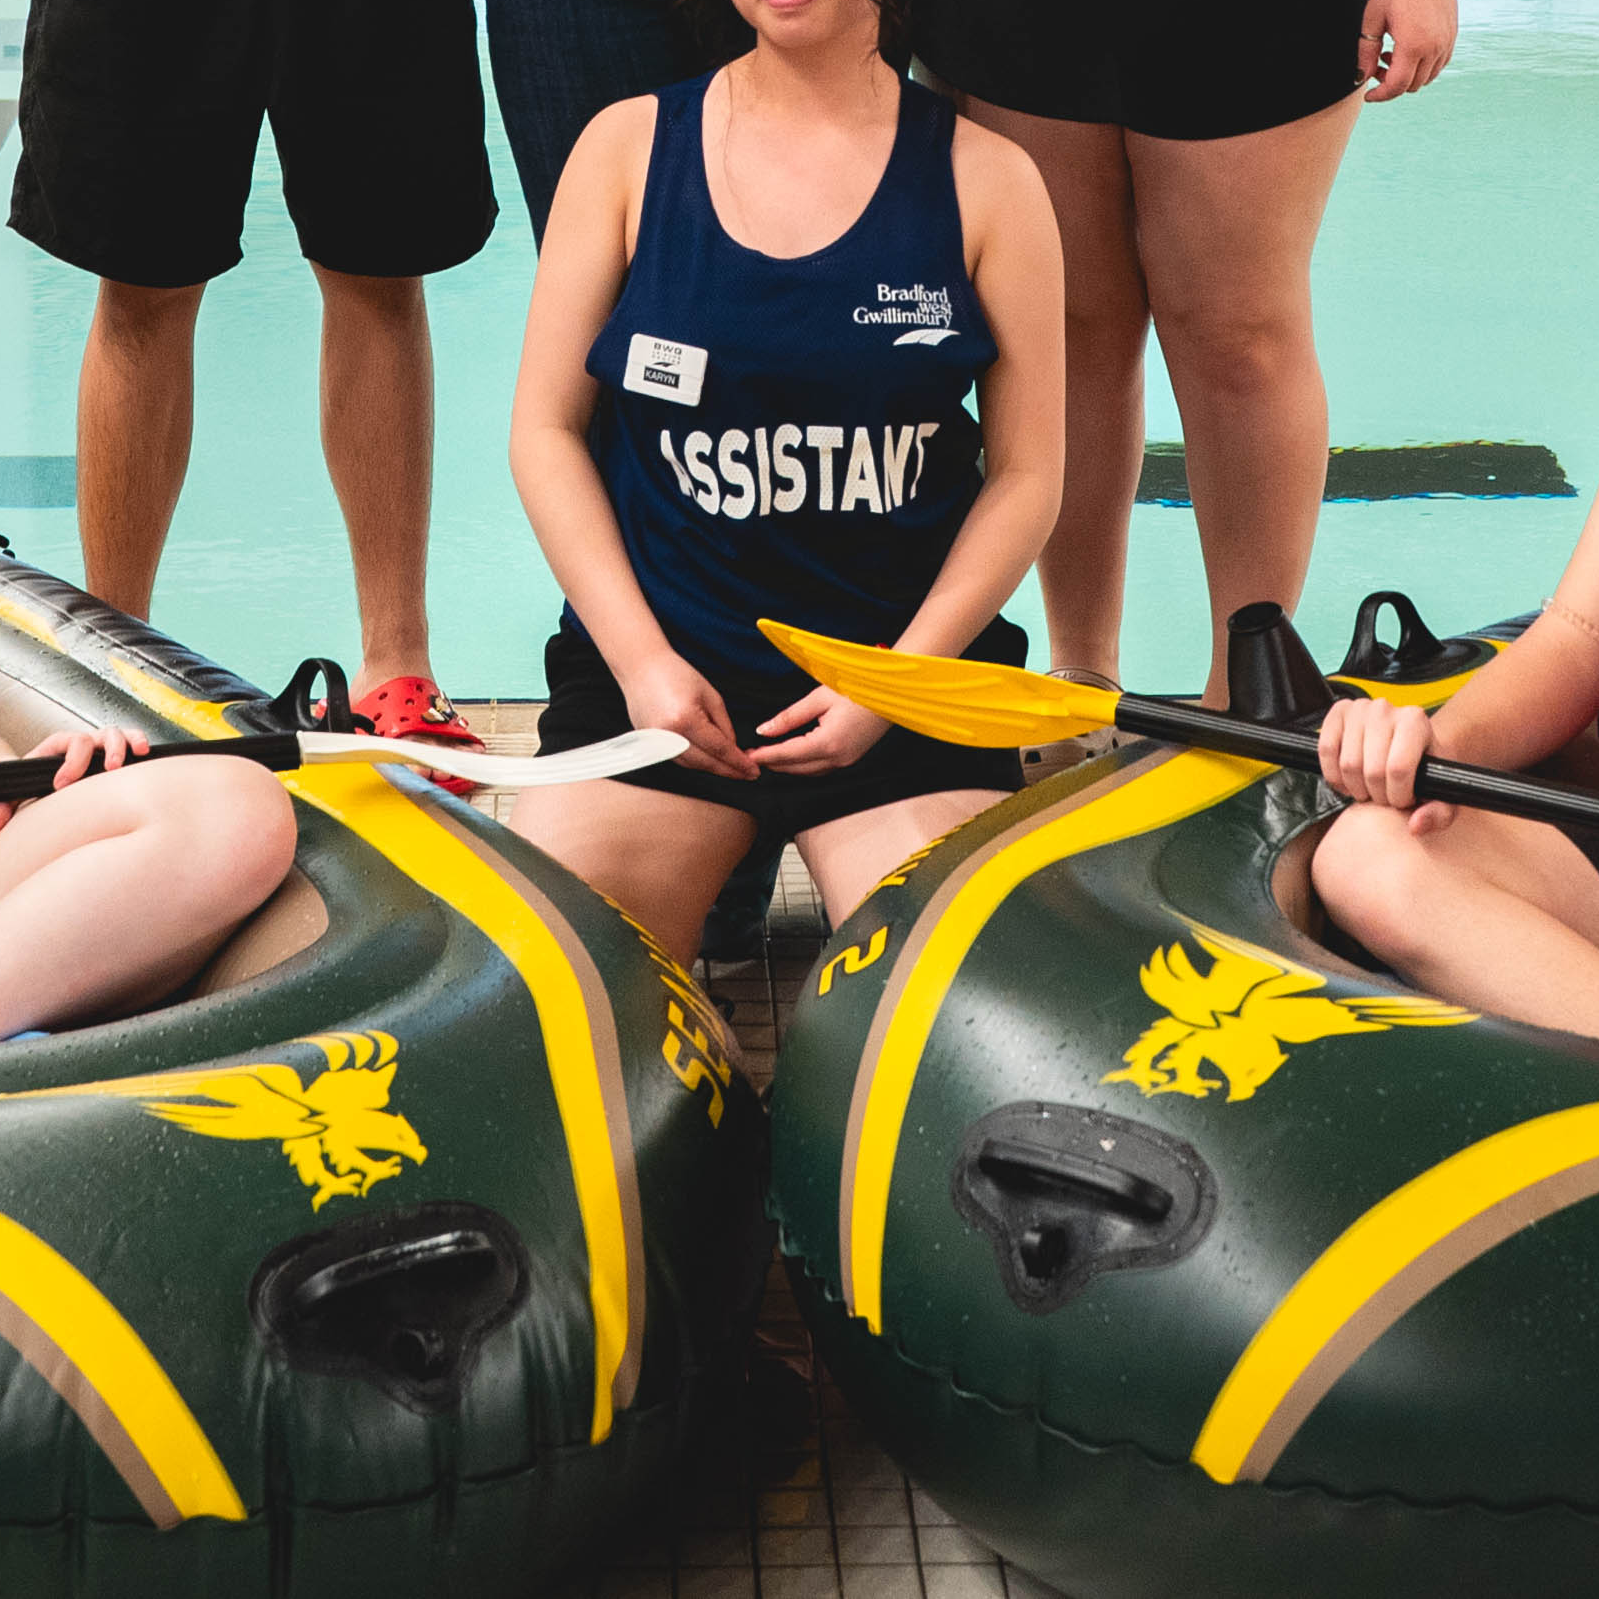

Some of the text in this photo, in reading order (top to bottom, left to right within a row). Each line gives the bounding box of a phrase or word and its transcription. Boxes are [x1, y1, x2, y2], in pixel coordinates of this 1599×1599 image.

[876, 283, 949, 303] Bradford
[853, 306, 953, 329] Gwillimbury
[918, 302, 953, 315] west
[645, 369, 676, 386] KARYN
